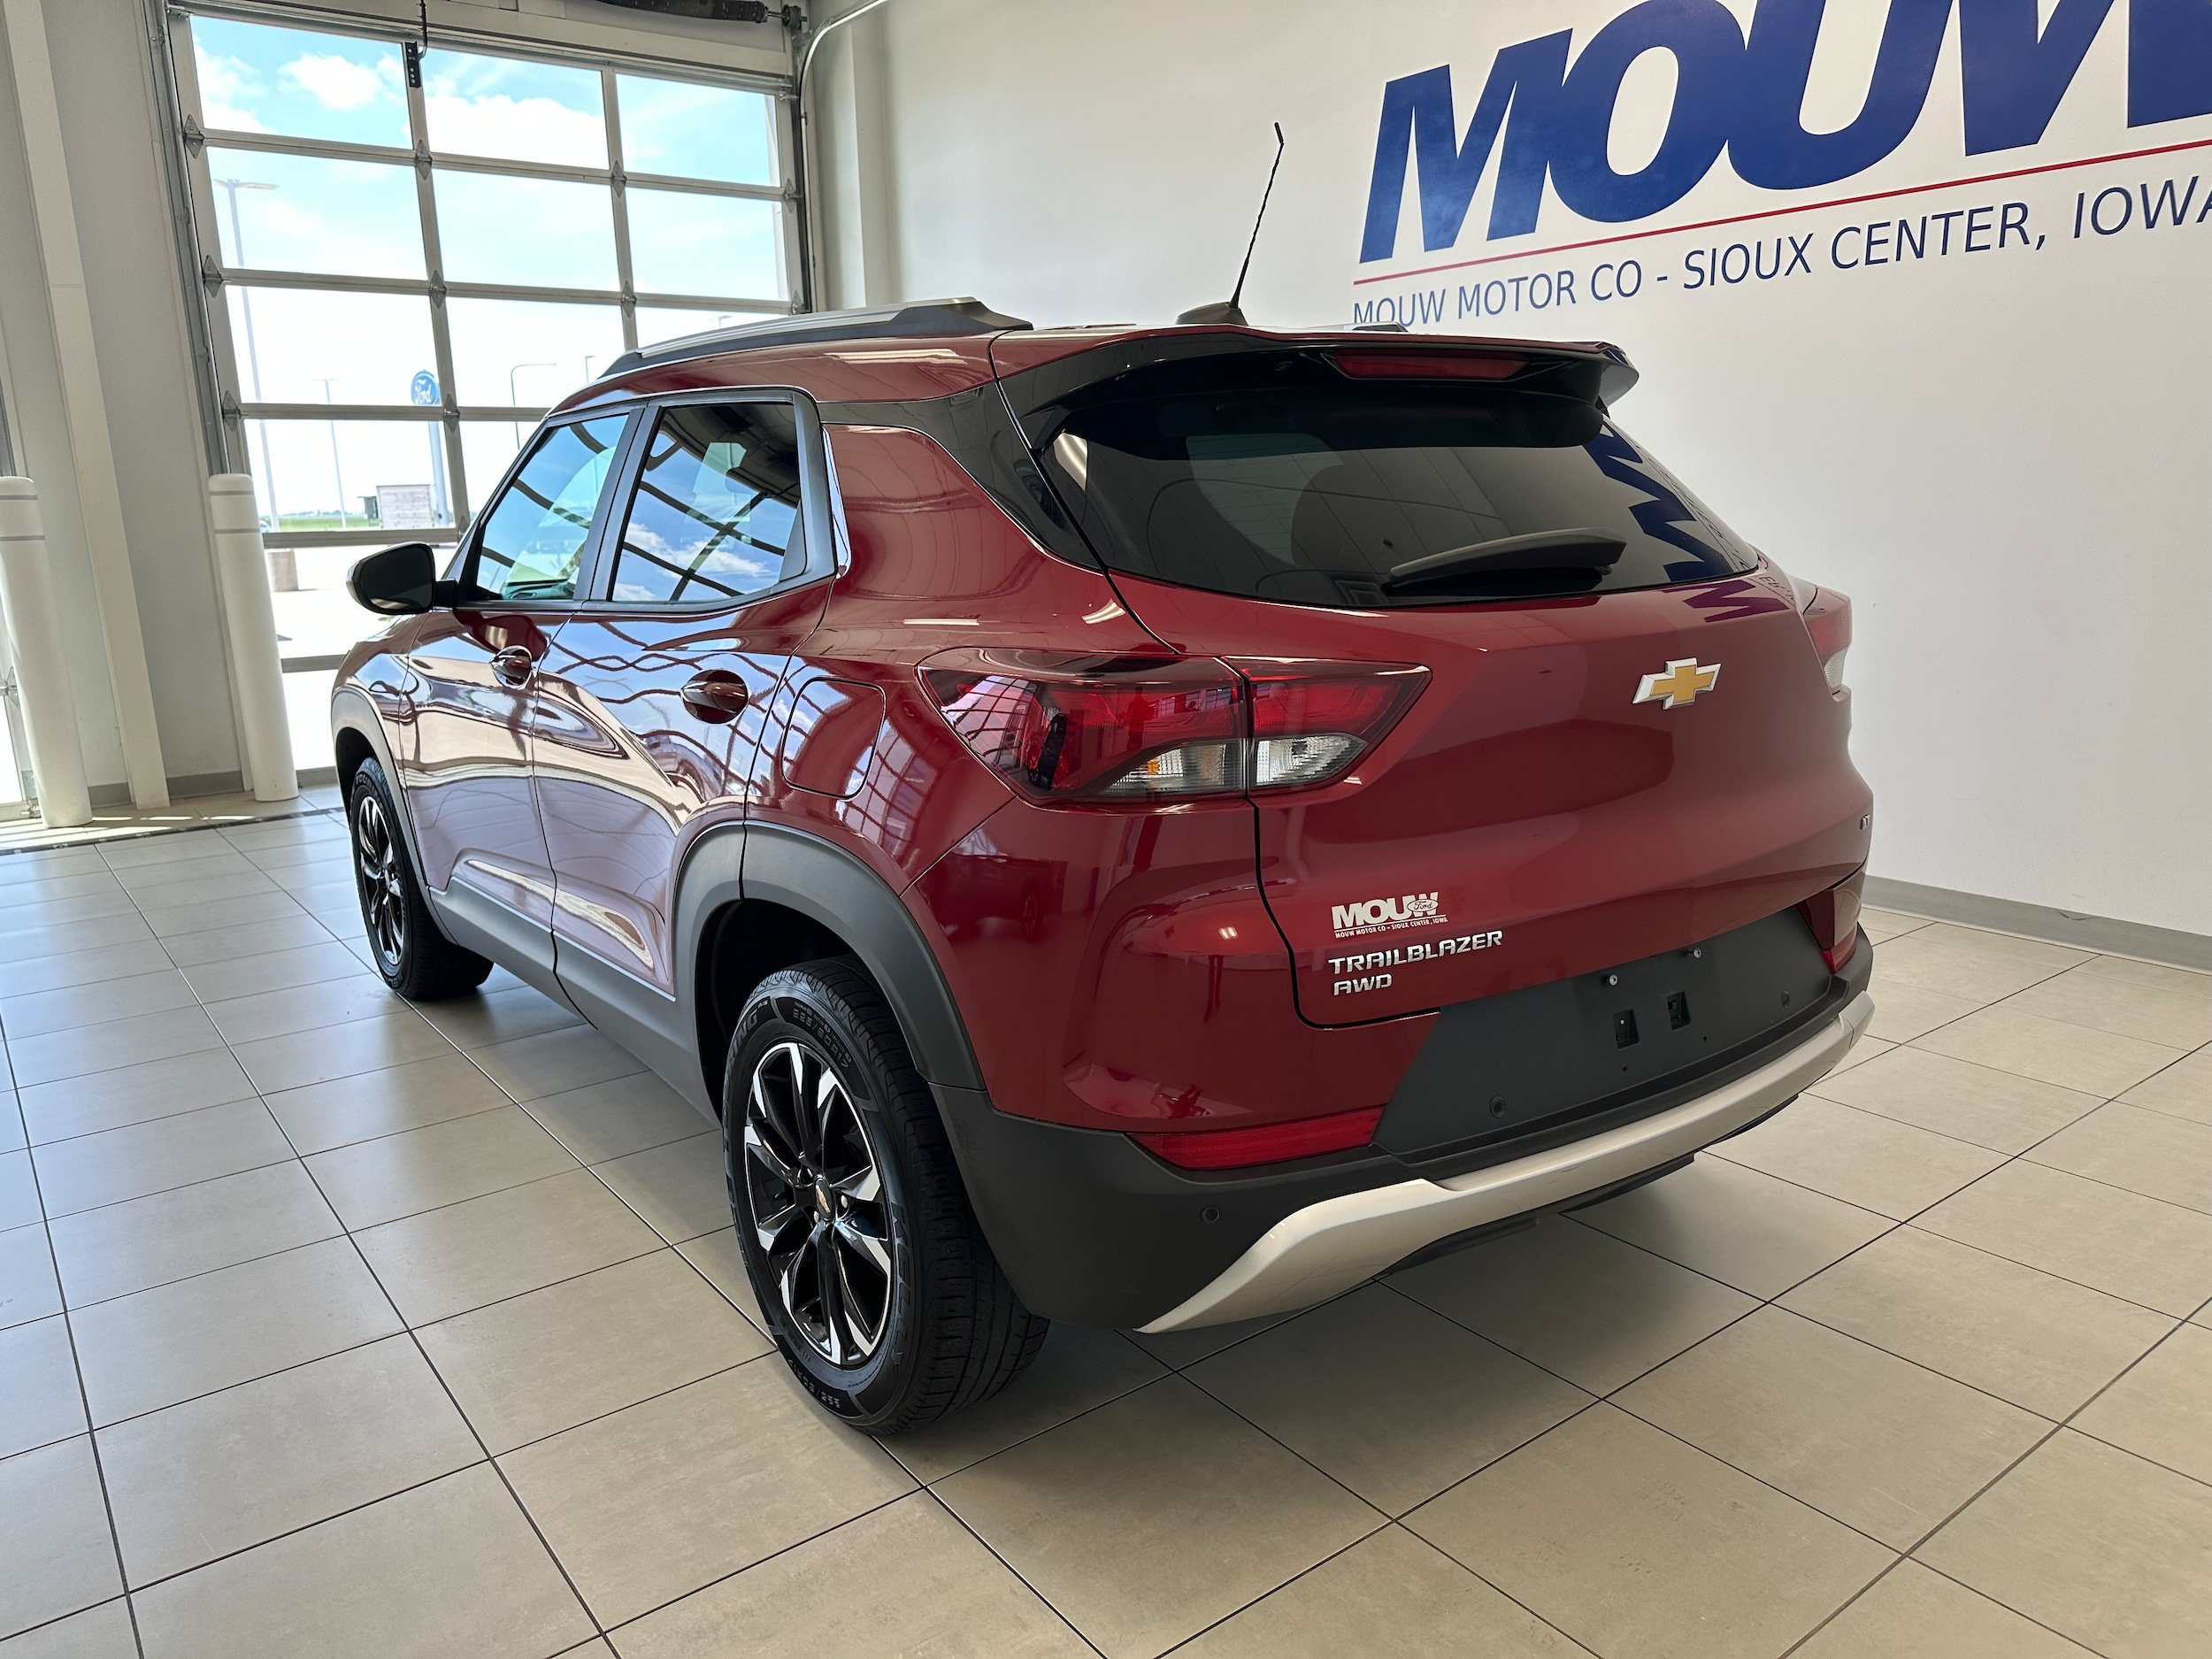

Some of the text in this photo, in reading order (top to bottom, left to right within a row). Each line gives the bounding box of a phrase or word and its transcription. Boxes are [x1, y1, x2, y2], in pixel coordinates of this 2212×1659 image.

[1354, 289, 1446, 326] MOUW
[1457, 270, 1576, 319] MOTOR
[1591, 259, 1641, 301] CO
[1684, 233, 1813, 290] SIOUX
[1831, 202, 2046, 269] CENTER,
[2073, 175, 2212, 239] IOW
[1413, 901, 1432, 910] Ford
[1328, 930, 1503, 974] TRAILBLAZER
[1333, 973, 1392, 995] AWD
[890, 1202, 912, 1374] KELLY
